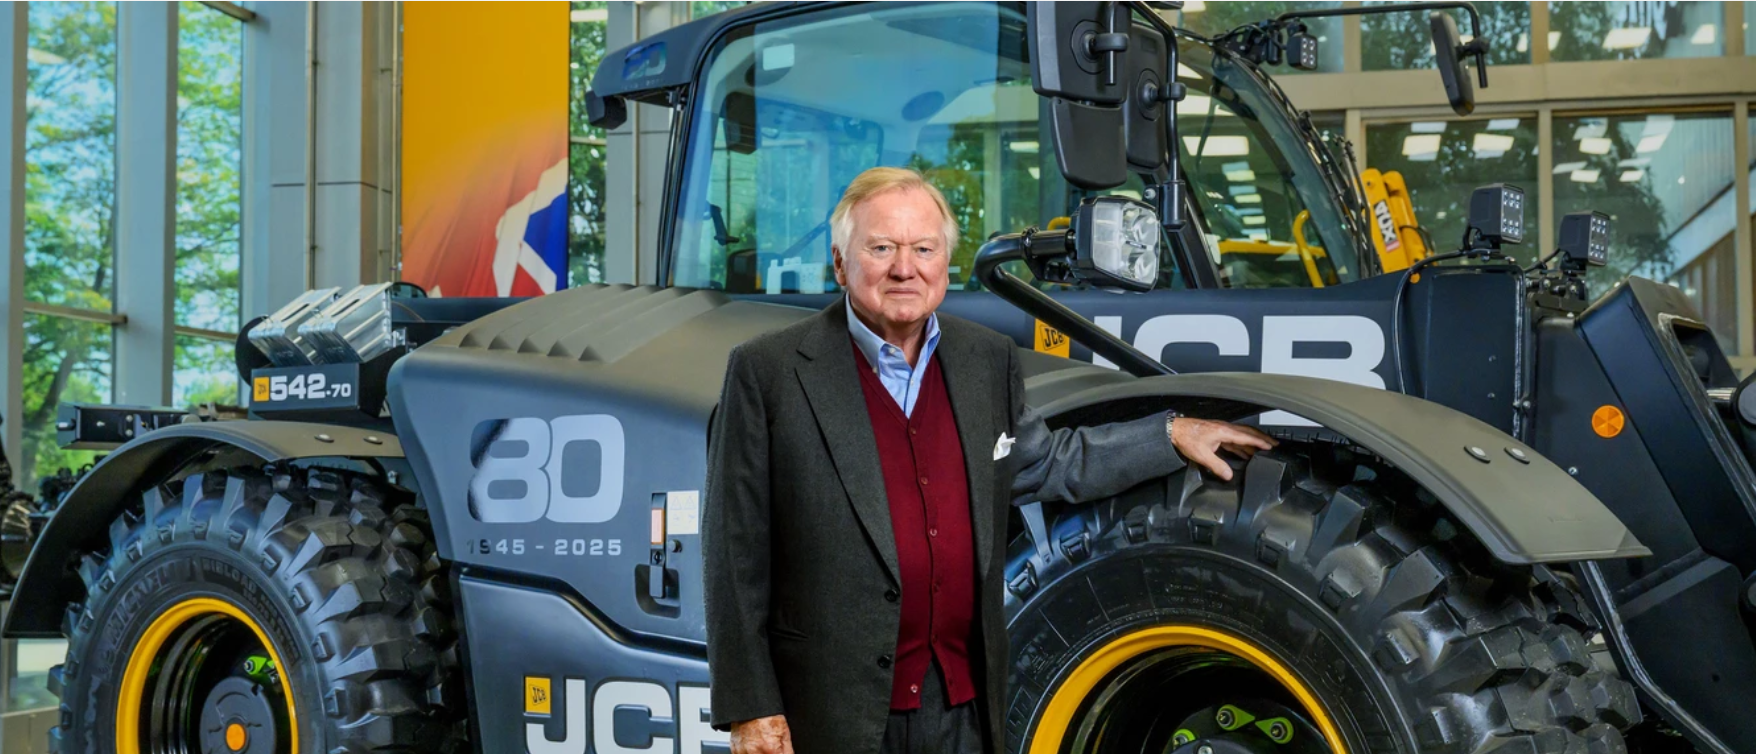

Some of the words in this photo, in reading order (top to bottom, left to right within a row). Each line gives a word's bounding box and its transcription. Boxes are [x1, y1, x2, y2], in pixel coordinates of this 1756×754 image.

[467, 413, 625, 523] 80
[467, 538, 525, 555] 1945
[554, 538, 622, 556] 2025
